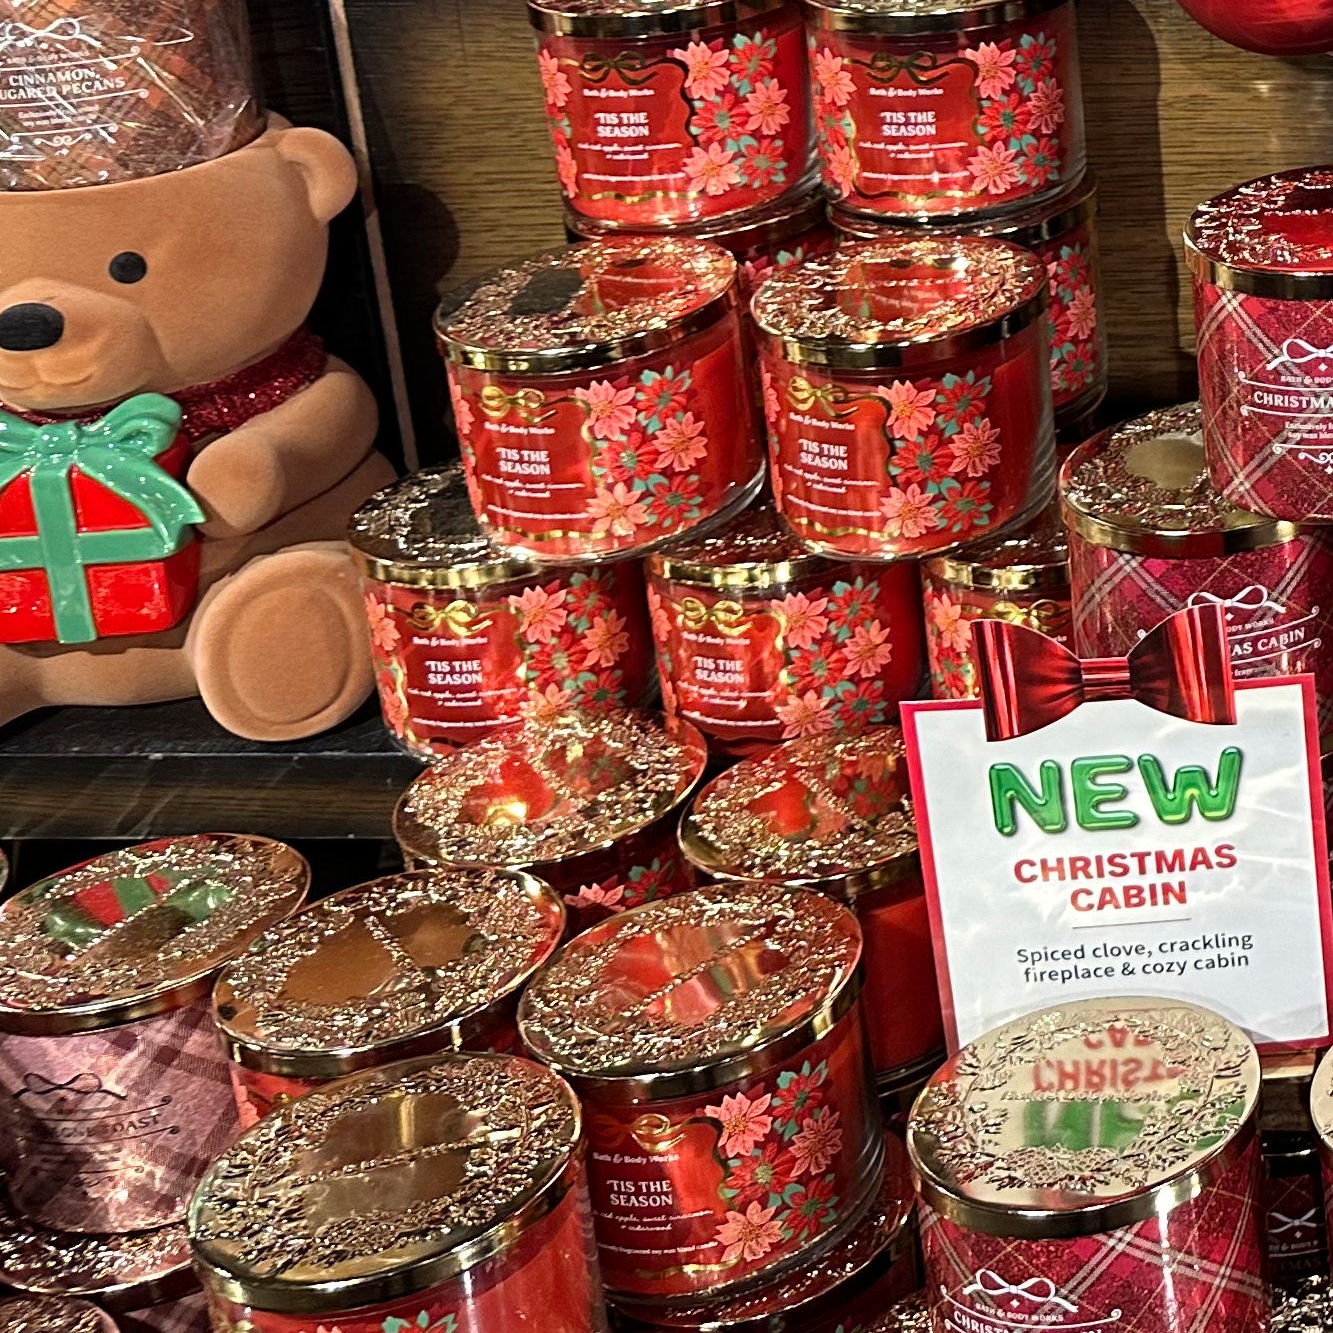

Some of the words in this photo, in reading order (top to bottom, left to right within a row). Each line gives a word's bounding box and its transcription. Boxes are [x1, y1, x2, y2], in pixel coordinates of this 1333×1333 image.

[0, 87, 57, 100] UGARED
[62, 77, 125, 95] PECANS
[621, 112, 649, 124] THE
[908, 111, 936, 123] THE
[597, 125, 649, 138] SEASON
[882, 124, 937, 137] SEASON
[522, 450, 549, 461] THE
[822, 443, 848, 457] THE
[499, 461, 550, 474] SEASON
[800, 452, 848, 470] SEASON
[1258, 627, 1305, 651] CABIN
[452, 660, 481, 672] THE
[717, 659, 743, 671] THE
[428, 673, 483, 685] SEASON
[695, 670, 745, 684] SEASON
[988, 745, 1244, 838] NEW
[1013, 844, 1238, 884] CHRISTMAS
[1070, 881, 1188, 912] CABIN
[1017, 944, 1086, 966] Spiced
[1092, 943, 1153, 958] clove,
[1158, 932, 1254, 954] crackling
[1023, 966, 1115, 984] fireplace
[1121, 962, 1136, 976] &
[1142, 960, 1187, 975] cozy
[1193, 953, 1250, 970] cabin
[105, 1114, 161, 1133] OAST
[606, 1179, 636, 1193] 'TIS
[642, 1179, 672, 1193] THE
[609, 1193, 673, 1207] SEASON
